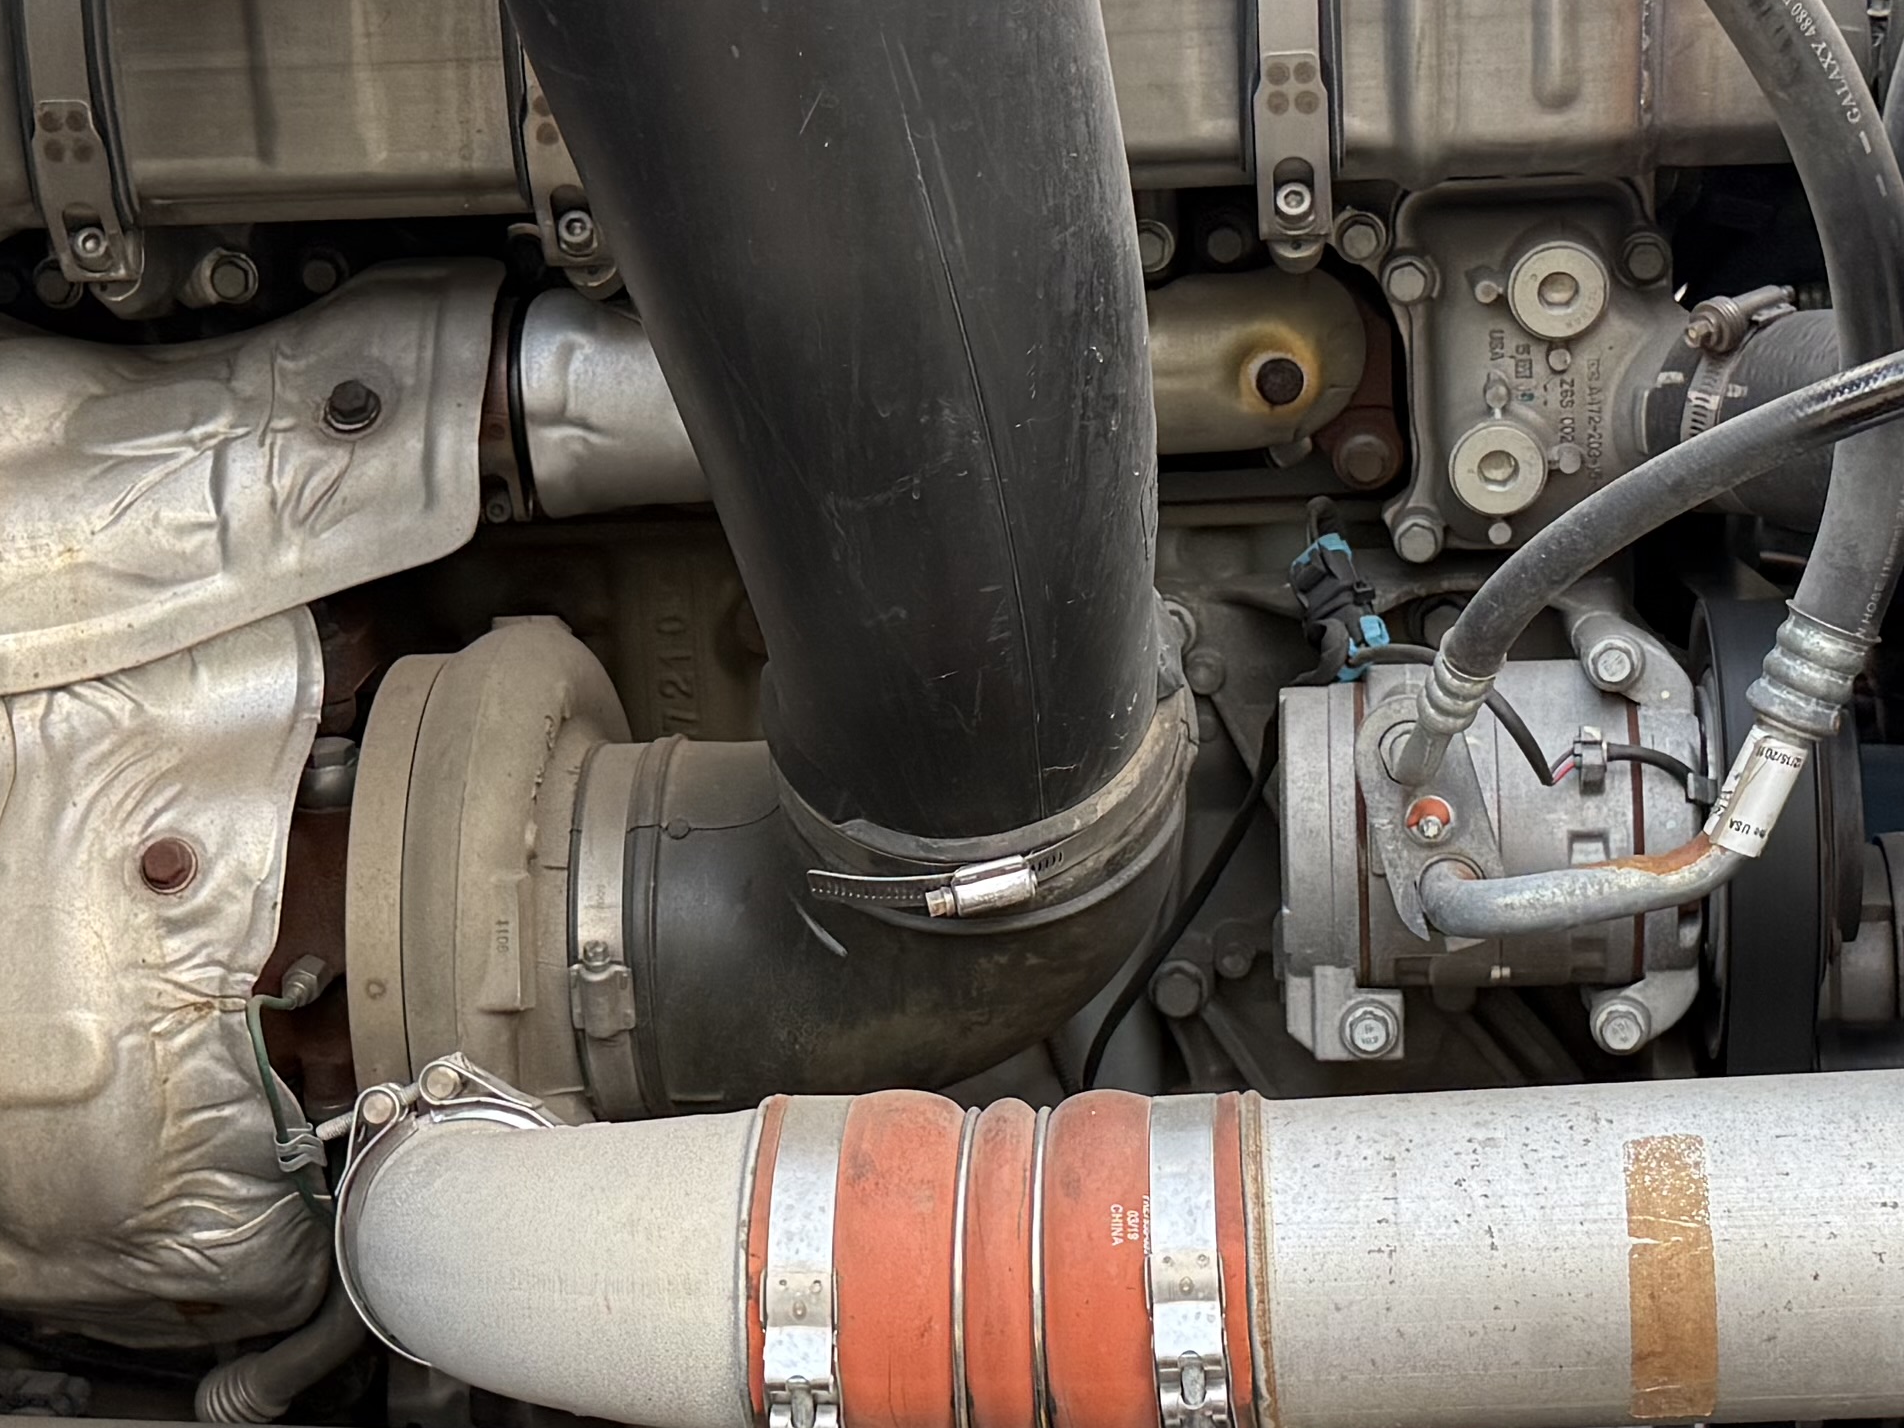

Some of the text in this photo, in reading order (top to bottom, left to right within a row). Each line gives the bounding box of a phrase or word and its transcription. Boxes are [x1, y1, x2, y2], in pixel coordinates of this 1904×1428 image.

[1788, 0, 1820, 38] 4880
[1809, 36, 1865, 124] GALAXY
[1489, 329, 1504, 361] USA
[1729, 818, 1751, 835] USA
[1110, 1203, 1124, 1246] CHINA
